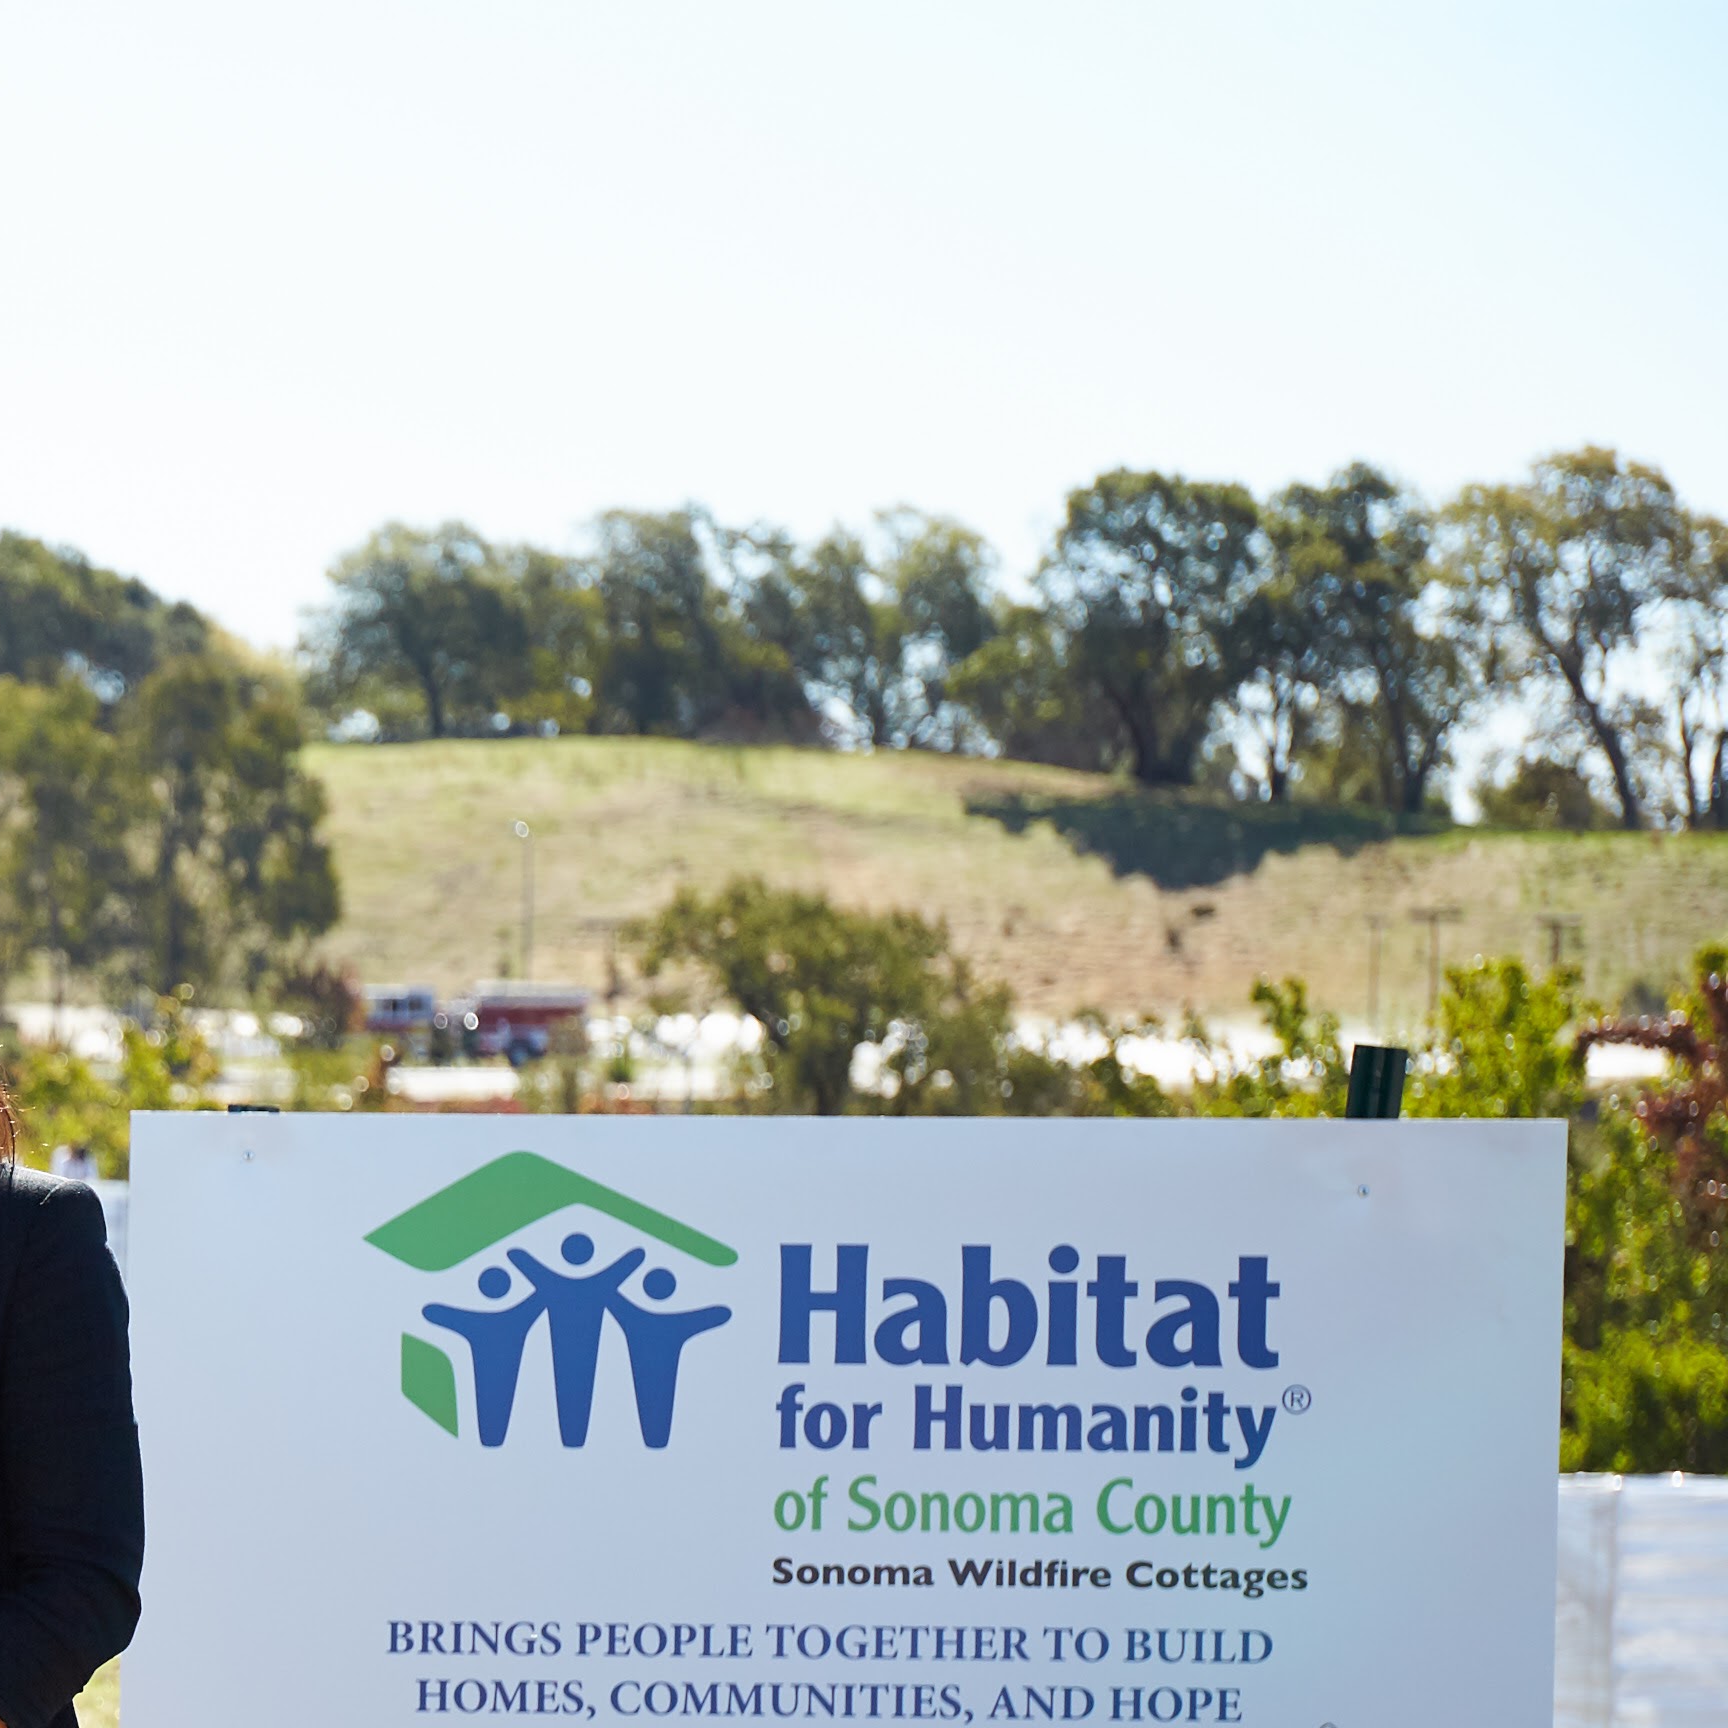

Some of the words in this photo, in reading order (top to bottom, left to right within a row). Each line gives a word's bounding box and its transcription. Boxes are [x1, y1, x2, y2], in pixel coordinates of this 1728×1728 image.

[778, 1244, 1280, 1370] Habitat
[776, 1383, 882, 1450] for
[774, 1475, 829, 1531] of
[848, 1475, 1073, 1534] Sonoma
[1097, 1478, 1291, 1549] County
[773, 1558, 934, 1586] Sonoma
[948, 1559, 1111, 1588] Wildfire
[1126, 1561, 1307, 1598] Cottages
[389, 1622, 561, 1655] BRINGS
[578, 1624, 752, 1657] PEOPLE
[766, 1625, 1029, 1660] TOGETHER
[1043, 1628, 1109, 1661] TO
[1126, 1629, 1272, 1663] BUILD
[418, 1680, 596, 1719] HOMES,
[611, 1682, 973, 1724] COMMUNITIES,
[989, 1686, 1094, 1719] AND
[1111, 1688, 1242, 1722] HOPE
